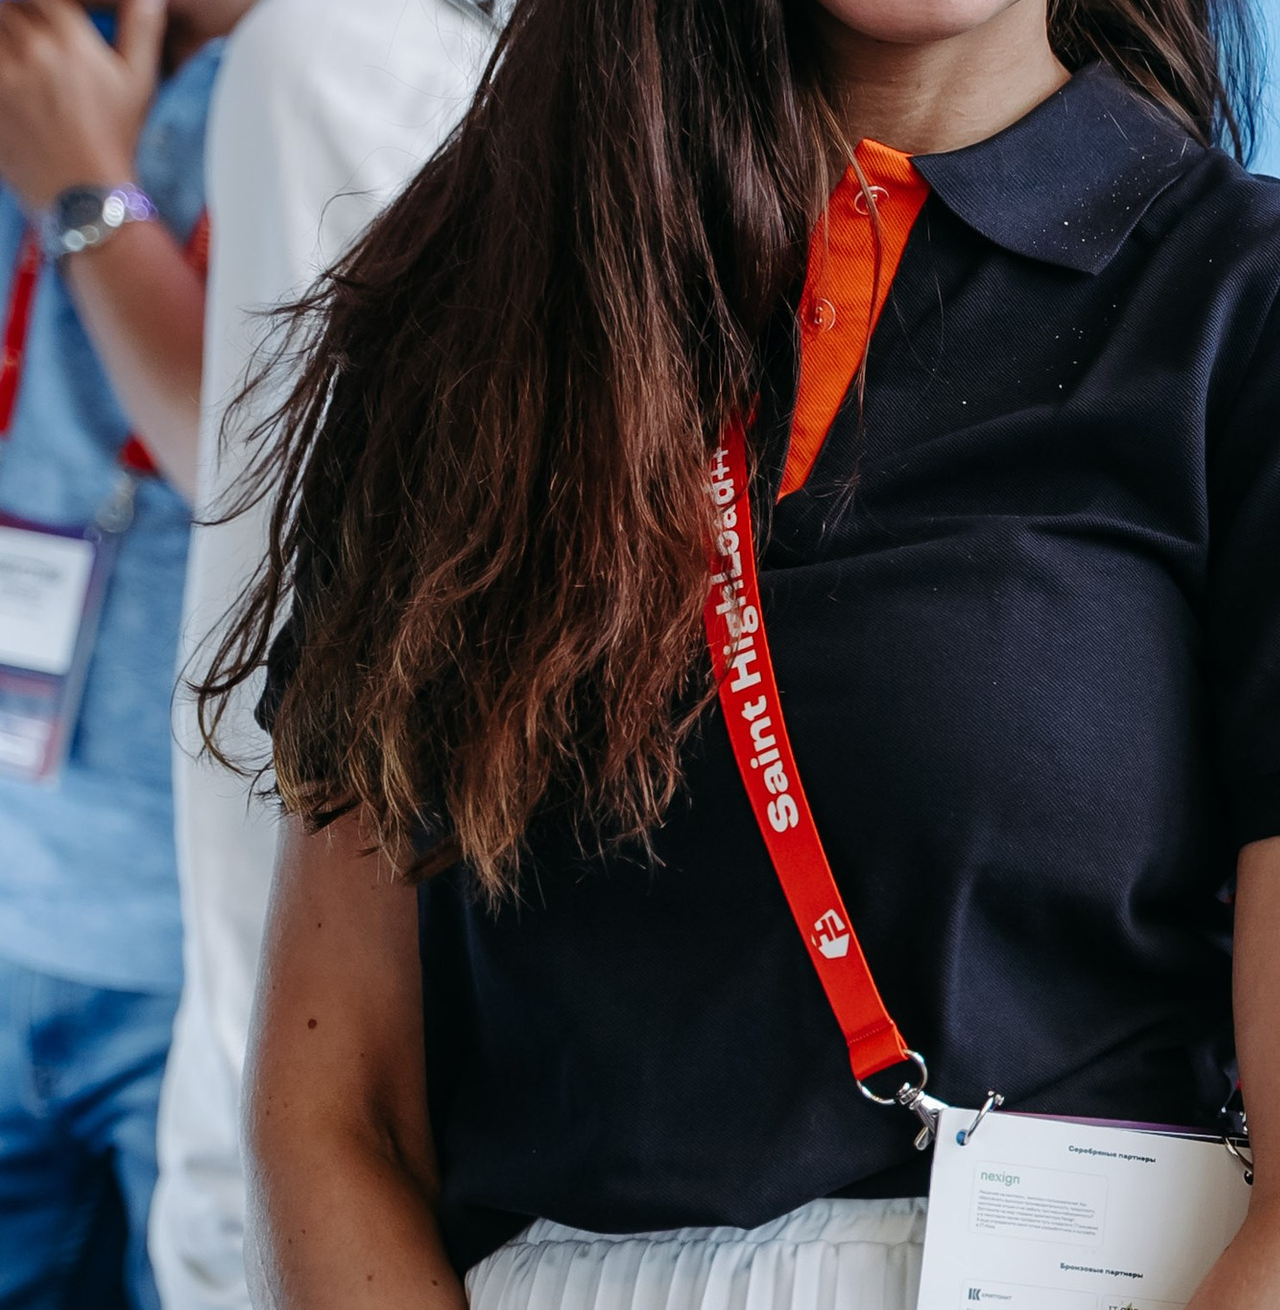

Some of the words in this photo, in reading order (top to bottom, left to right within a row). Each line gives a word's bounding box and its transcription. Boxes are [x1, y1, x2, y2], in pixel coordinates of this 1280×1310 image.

[741, 695, 799, 833] Saint
[1068, 1145, 1117, 1158] Серебряные
[1118, 1153, 1156, 1164] партнеры
[980, 1170, 1020, 1187] nexign
[1060, 1262, 1103, 1274] Бронзовые
[1105, 1269, 1143, 1279] партнеры
